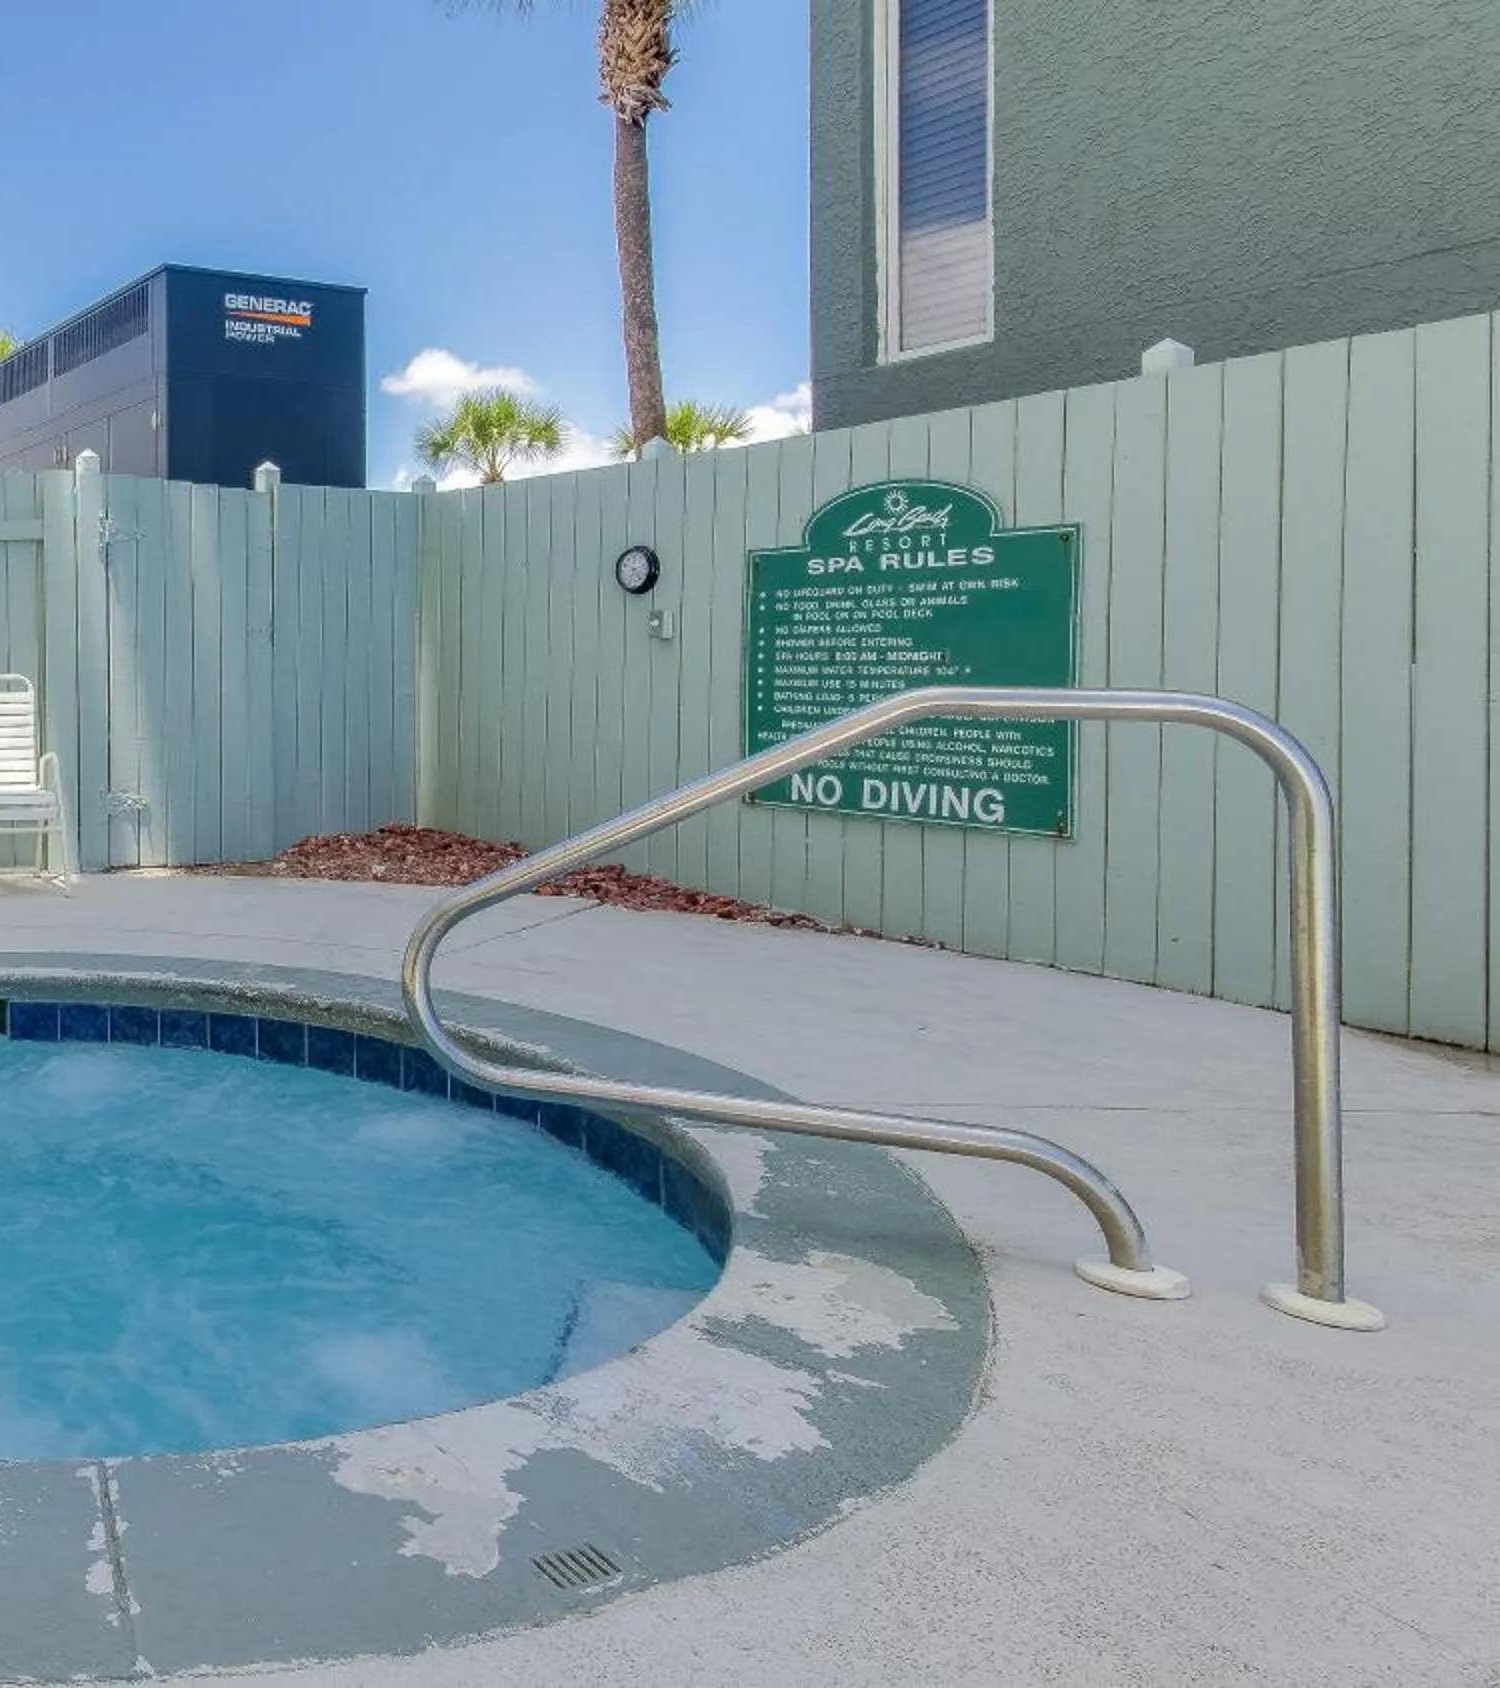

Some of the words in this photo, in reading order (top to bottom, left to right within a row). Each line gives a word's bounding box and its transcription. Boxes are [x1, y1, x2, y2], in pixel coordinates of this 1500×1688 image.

[225, 293, 310, 315] GENERAC
[225, 319, 301, 337] INDUSTRIAL
[225, 331, 275, 343] POWER
[849, 533, 947, 553] RESORT
[807, 556, 864, 575] SPA
[879, 546, 995, 572] RULES
[775, 589, 790, 599] NO
[847, 585, 863, 595] ON
[867, 584, 894, 595] DUTY
[908, 581, 937, 593] SWIM
[942, 581, 954, 591] AT
[959, 580, 986, 591] OWN
[991, 577, 1019, 589] RISK
[775, 602, 789, 611] NO
[900, 597, 916, 607] OR
[920, 595, 968, 606] ANIMALS
[805, 611, 831, 621] POOL
[835, 610, 849, 620] OR
[853, 610, 867, 619] ON
[871, 609, 899, 619] POOL
[903, 607, 933, 619] DECK
[775, 625, 789, 635] NO
[836, 623, 883, 633] ALLOWED
[775, 637, 814, 647] SHOWER
[818, 637, 857, 647] BEFORE
[861, 637, 913, 647] ENTERING
[775, 651, 792, 661] SPA
[860, 651, 877, 661] AM
[887, 651, 943, 661] MIDNIGHT
[774, 665, 819, 675] MAXIMUM
[822, 665, 854, 675] WATER
[857, 665, 930, 676] TEMPERATURE
[822, 679, 841, 689] USE
[860, 680, 905, 689] MINUTES
[773, 705, 819, 715] CHILDREN
[953, 729, 991, 739] PEOPLE
[996, 731, 1021, 741] WITH
[901, 739, 933, 750] USING
[991, 743, 1055, 757] NARCOTICS
[880, 751, 911, 761] CAUSE
[915, 753, 983, 767] DROWSINESS
[988, 757, 1032, 770] SHOULD
[849, 761, 889, 773] WITHOUT
[923, 766, 988, 780] CONSULTING
[790, 772, 843, 805] NO
[861, 778, 1005, 823] DIVING
